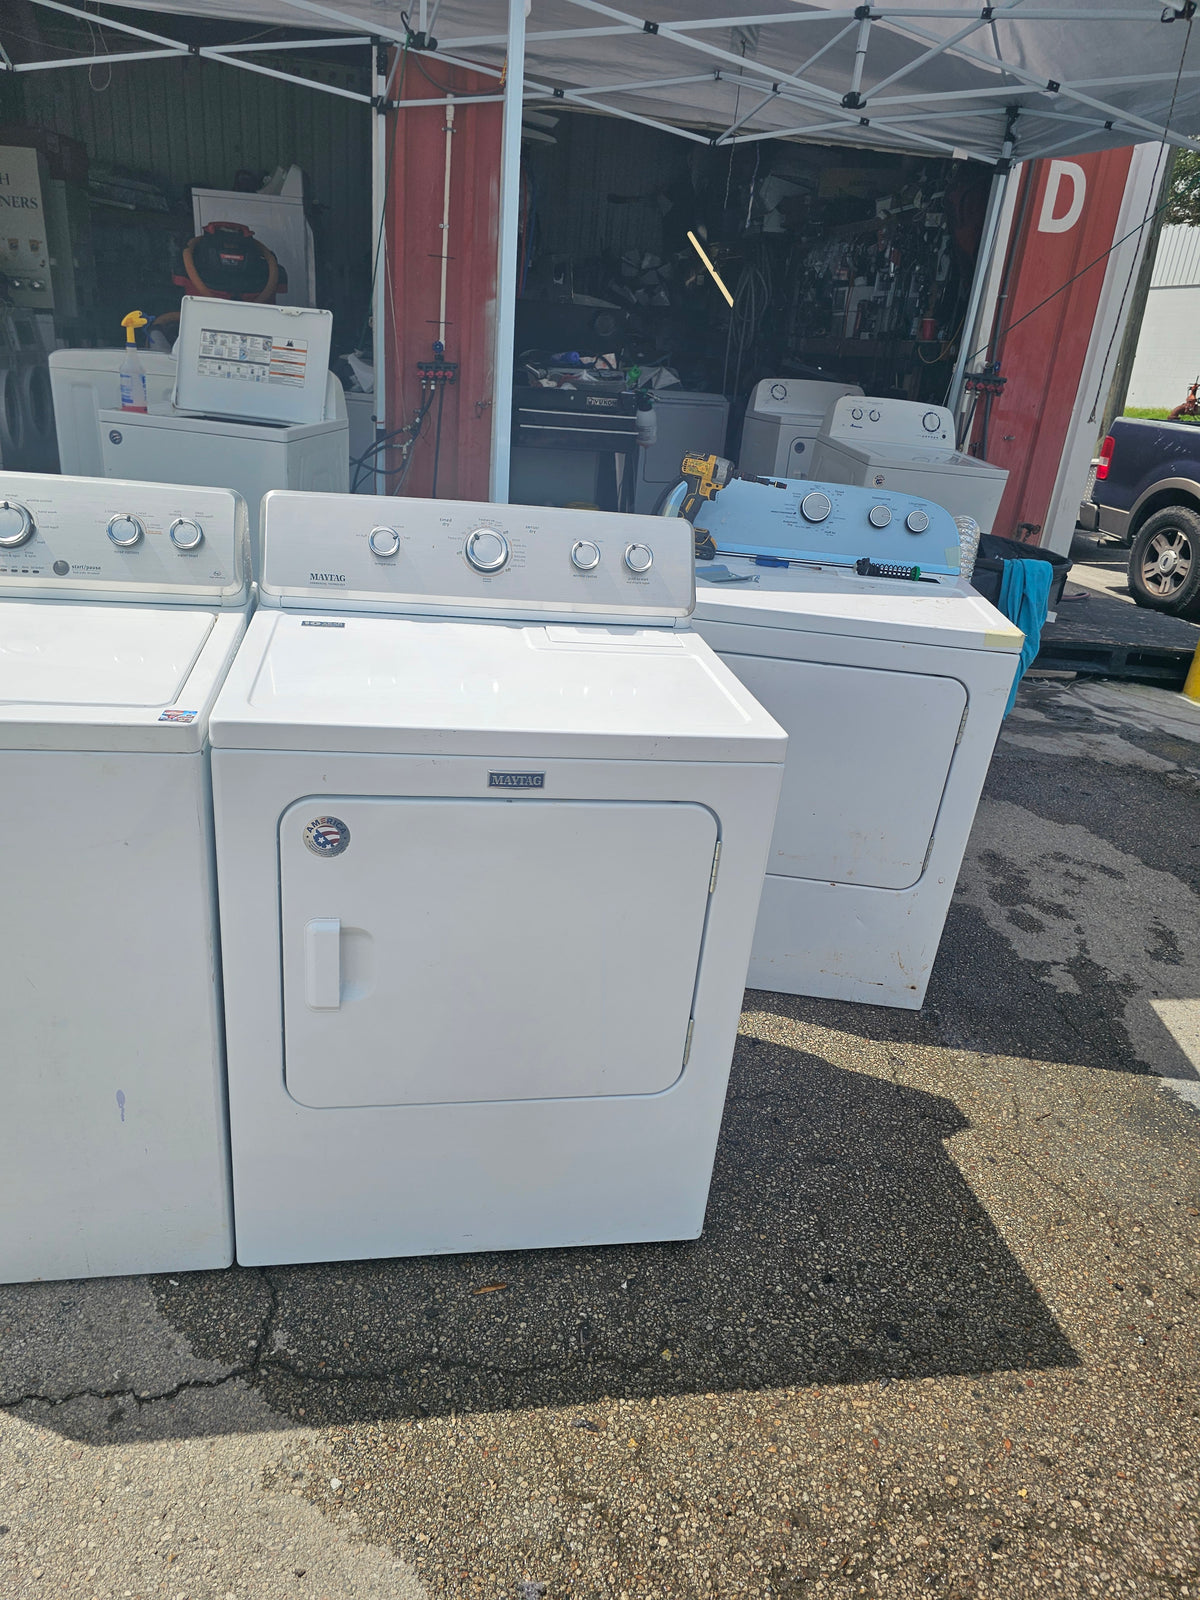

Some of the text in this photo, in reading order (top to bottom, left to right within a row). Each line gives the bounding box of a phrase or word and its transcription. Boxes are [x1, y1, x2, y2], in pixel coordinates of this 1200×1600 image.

[1037, 159, 1087, 233] D
[310, 572, 346, 582] MAYTAG
[491, 775, 542, 786] MAYTAG
[306, 817, 347, 834] AMERICA
